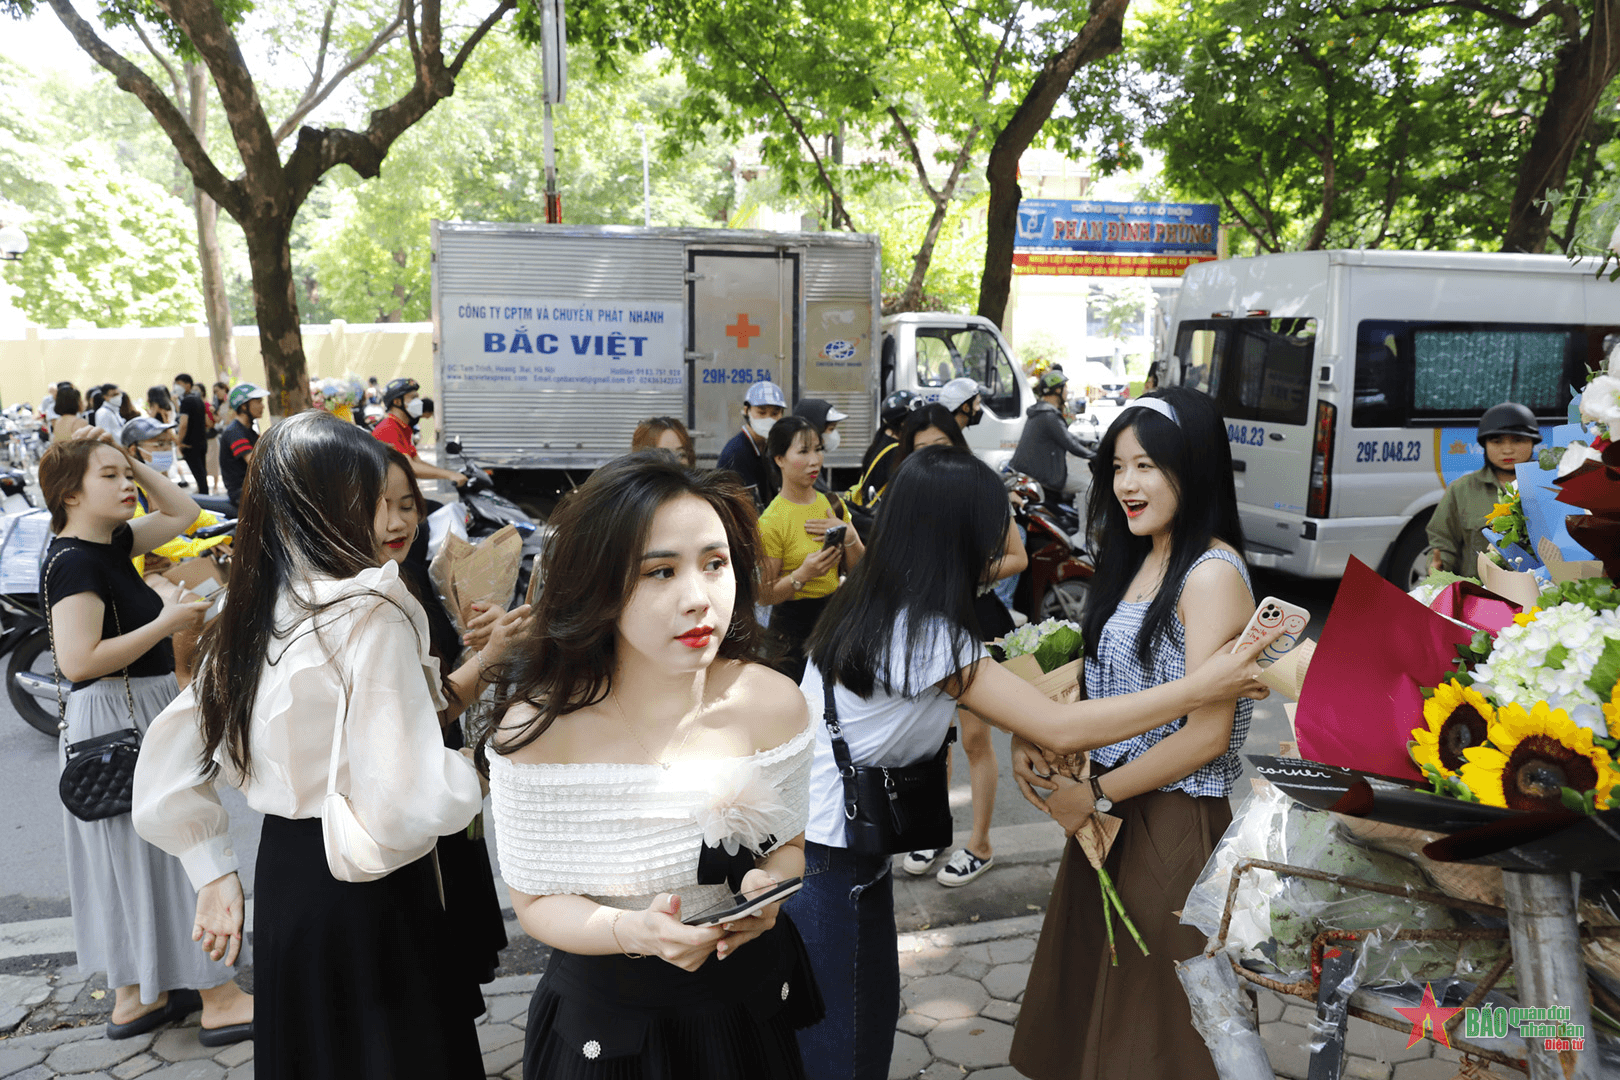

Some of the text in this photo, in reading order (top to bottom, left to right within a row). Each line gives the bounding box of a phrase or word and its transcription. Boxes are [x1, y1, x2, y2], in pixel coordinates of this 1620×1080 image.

[1052, 214, 1213, 244] PHAN ĐÌNH PHÙNG
[458, 303, 487, 319] CÔNG
[490, 306, 501, 320] TY
[504, 306, 533, 320] CPTM
[536, 304, 549, 320] VÀ
[598, 307, 624, 323] PHÁT
[628, 310, 664, 324] NHANH
[484, 325, 649, 360] BẮC VIỆT
[1356, 440, 1421, 462] 29F.048.23
[1256, 766, 1332, 779] corner
